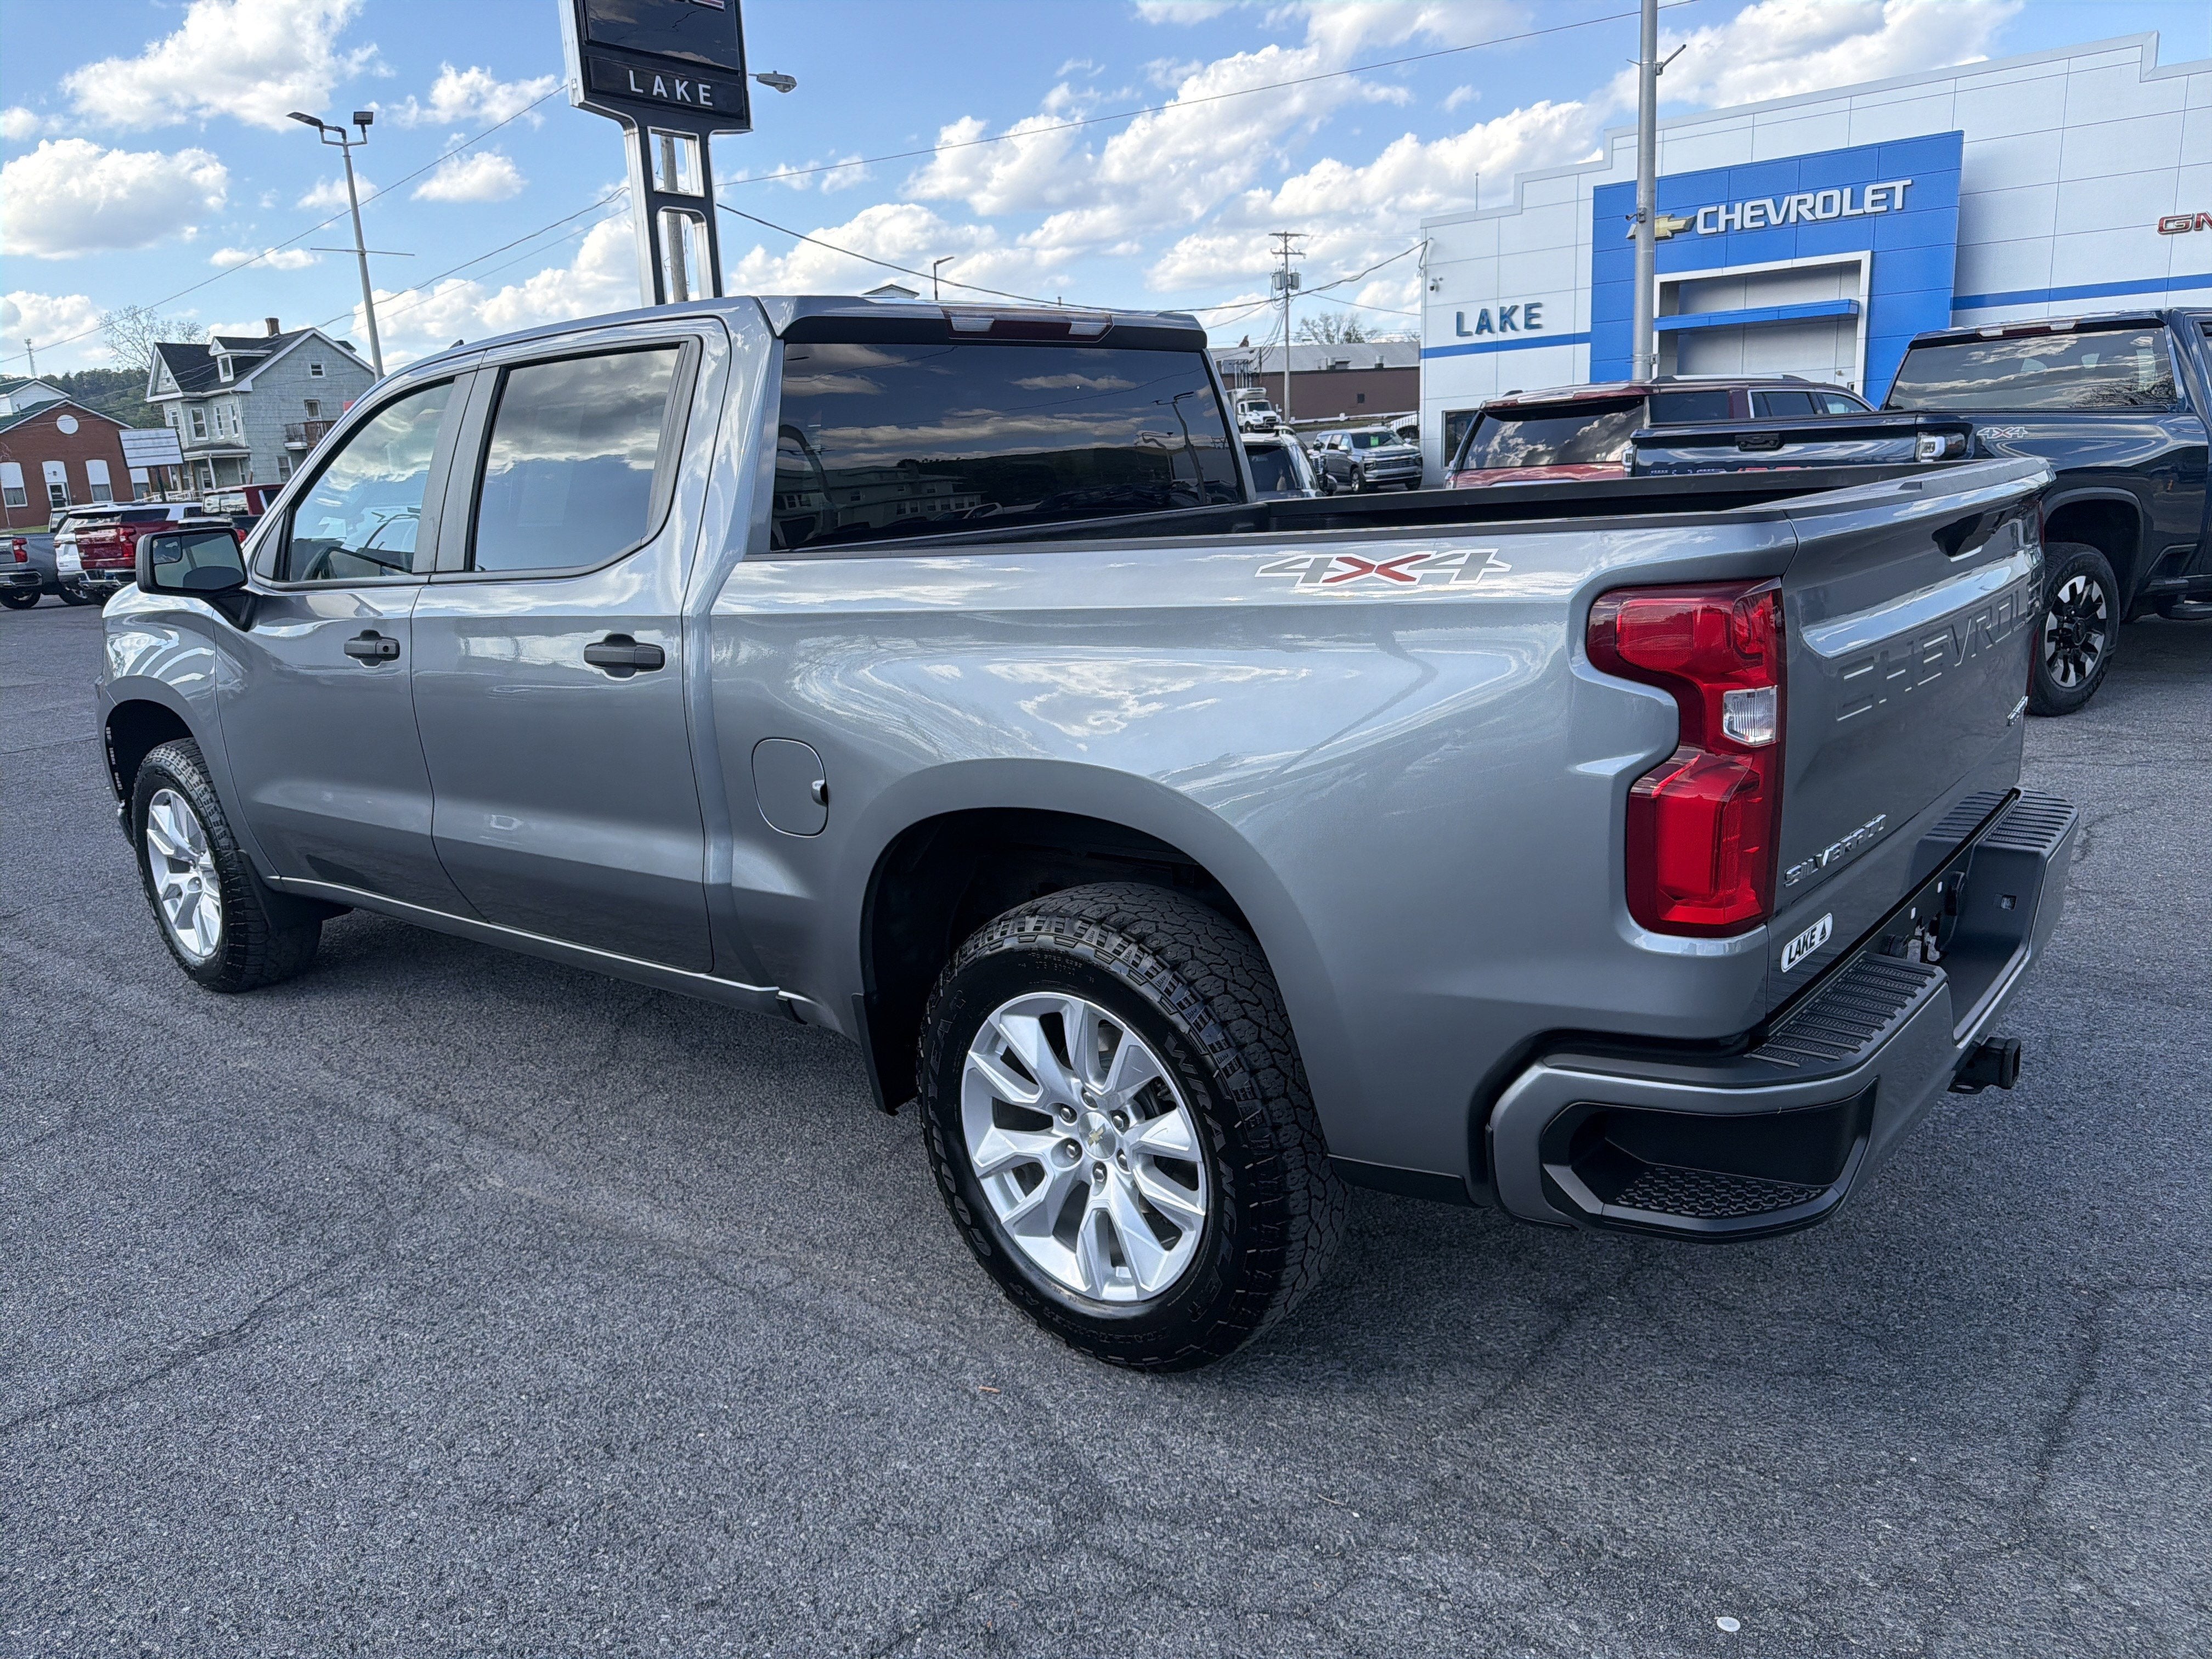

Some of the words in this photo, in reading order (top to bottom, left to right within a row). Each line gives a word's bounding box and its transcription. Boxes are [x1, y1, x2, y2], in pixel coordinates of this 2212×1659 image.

[629, 70, 713, 106] LAKE
[1697, 179, 1913, 235] CHEVROLET
[1456, 302, 1543, 337] LAKE
[1787, 926, 1818, 962] LAKE
[927, 989, 992, 1257] GOODYEAR
[1164, 1032, 1237, 1323] WRANGLER
